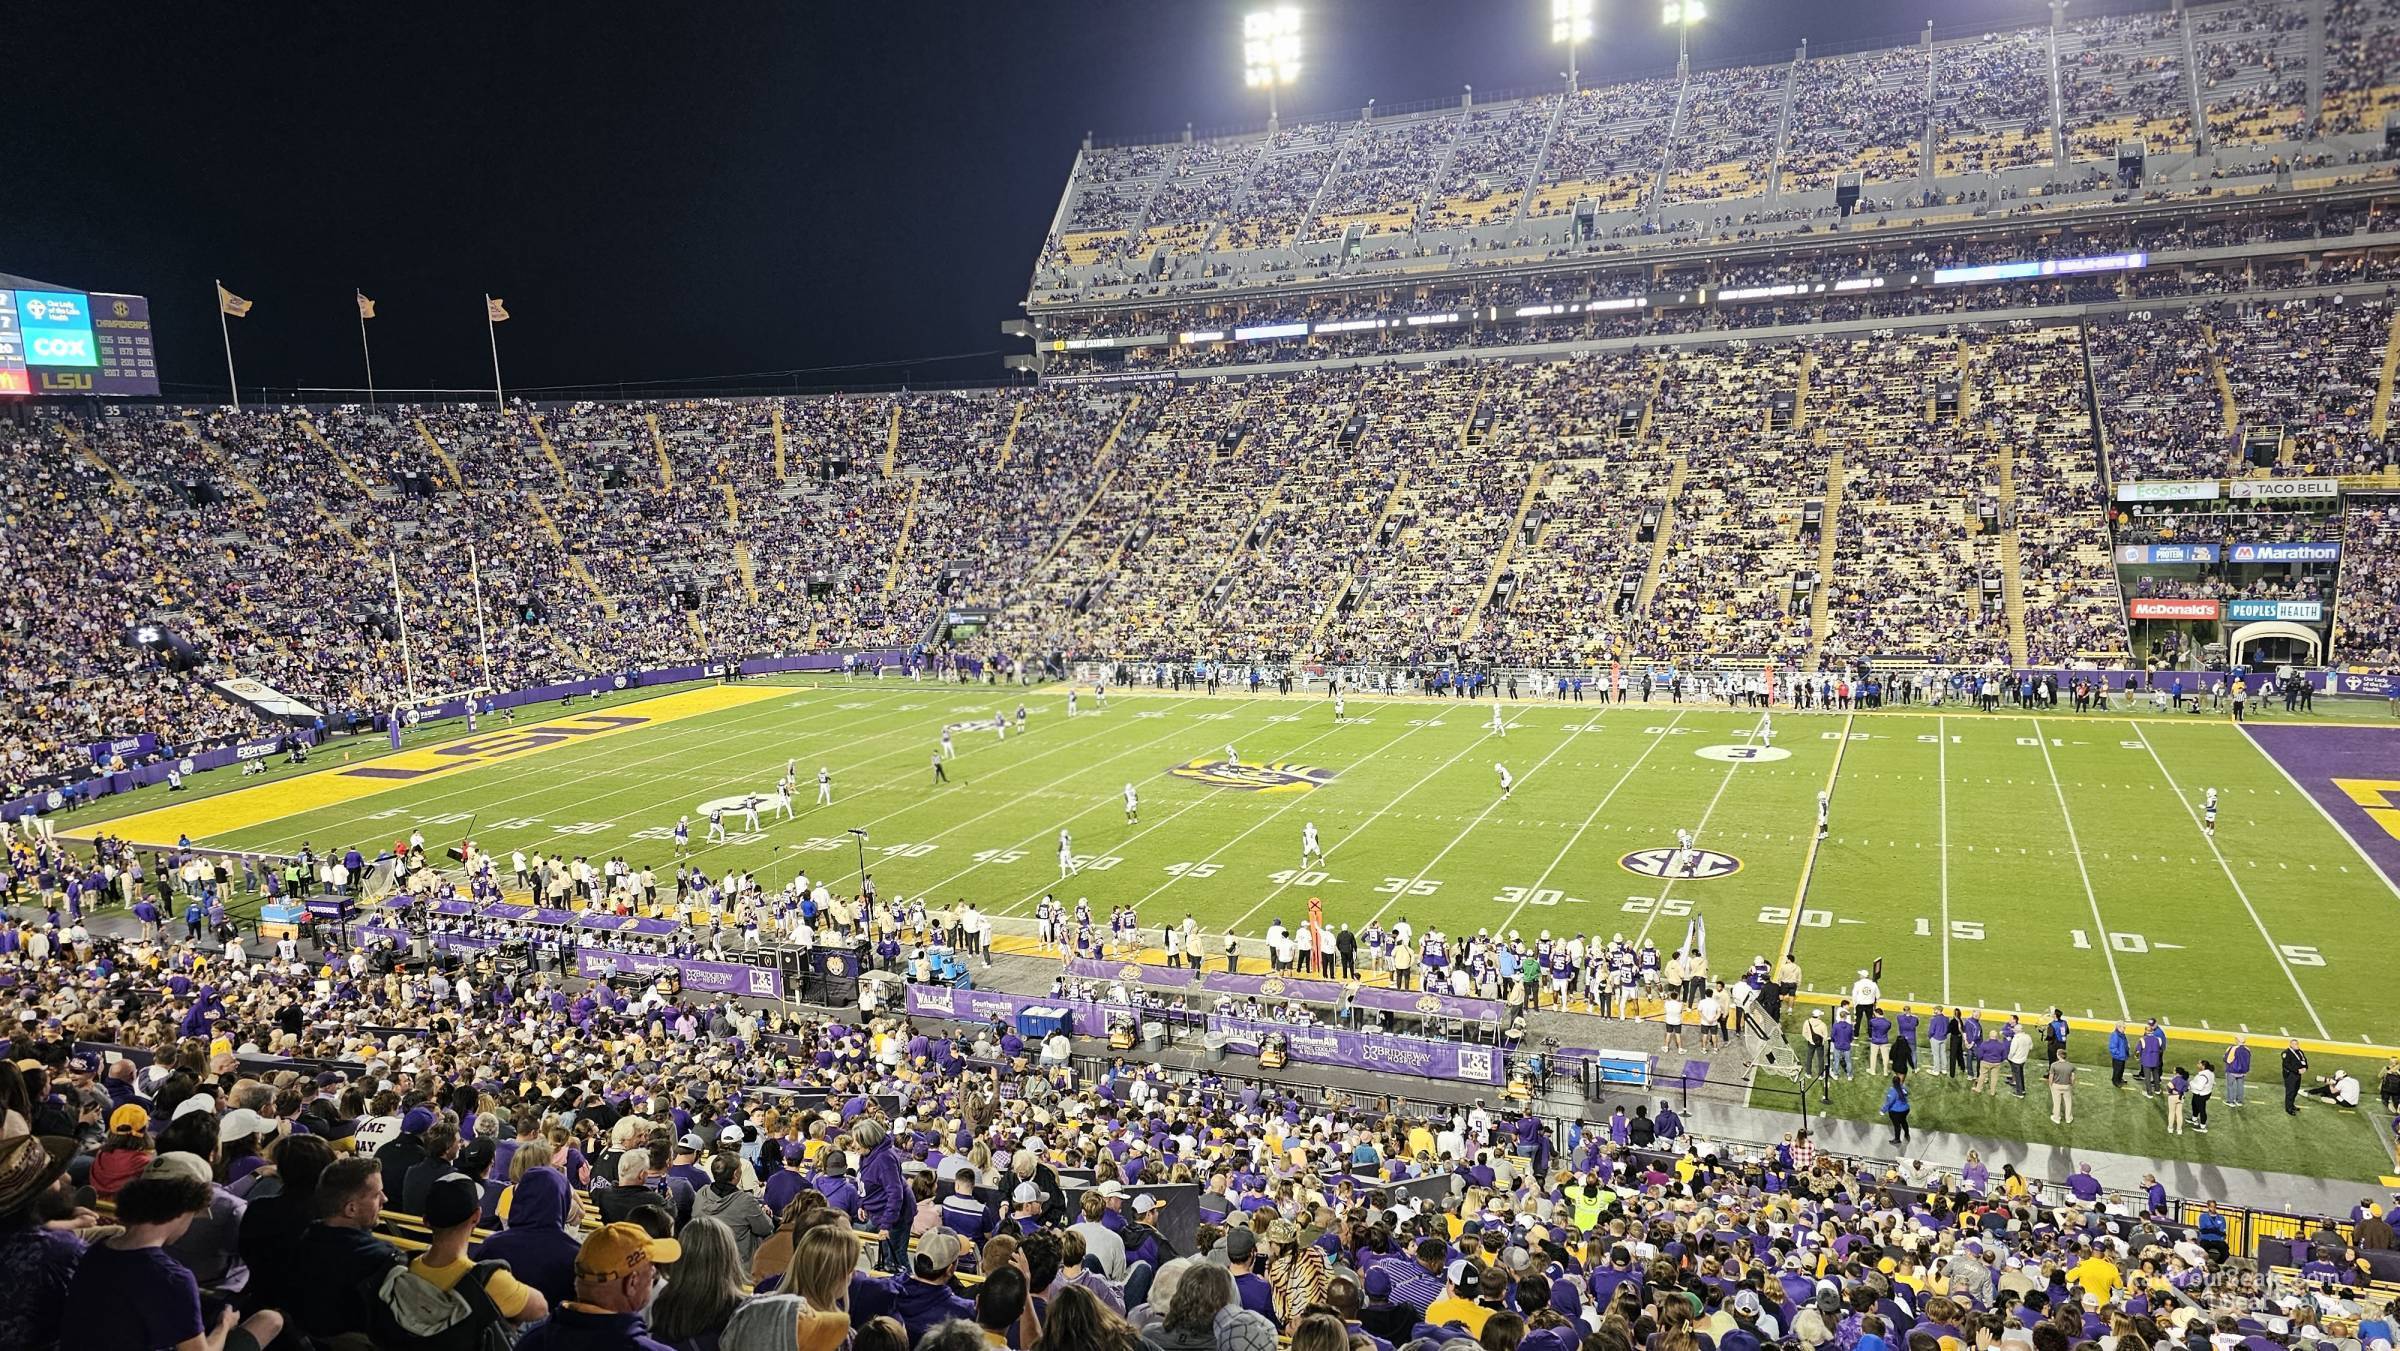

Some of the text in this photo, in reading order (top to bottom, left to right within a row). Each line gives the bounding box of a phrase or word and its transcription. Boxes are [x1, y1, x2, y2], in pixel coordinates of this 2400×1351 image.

[96, 319, 149, 330] CHAMPIONSHIPS
[34, 338, 86, 357] COX
[42, 372, 92, 390] LSU
[1211, 376, 1227, 384] 300
[2136, 484, 2198, 498] EcoSport
[2257, 481, 2333, 494] TACO BELL
[2257, 546, 2336, 559] Marathon
[2136, 604, 2216, 616] McDonald's
[2233, 604, 2317, 617] PEOPLES HEALTH
[335, 716, 650, 779] LSU
[789, 837, 853, 850] 35
[882, 843, 940, 857] 40
[972, 849, 1029, 864] 45
[1062, 855, 1124, 870] 50
[1629, 850, 1735, 877] SEC
[1163, 862, 1224, 878] 45
[1267, 870, 1330, 886] 40
[1373, 878, 1444, 896] 35
[1493, 886, 1565, 906] 30
[308, 906, 338, 914] POWERADE
[1620, 896, 1695, 917] 25
[1758, 906, 1834, 928] 20
[1914, 918, 1986, 940] 15
[2070, 929, 2150, 953] 10
[1539, 944, 1550, 954] 99
[2278, 945, 2327, 966] 5
[1643, 955, 1656, 965] 90
[1621, 971, 1633, 982] 93
[1290, 1034, 1338, 1047] SouthernAIR
[1377, 1046, 1431, 1063] BRIDGEWAY
[1387, 1055, 1422, 1067] HOSPICE
[1462, 1069, 1489, 1078] RENTALS
[1475, 1120, 1483, 1133] 9
[626, 1251, 646, 1268] 225
